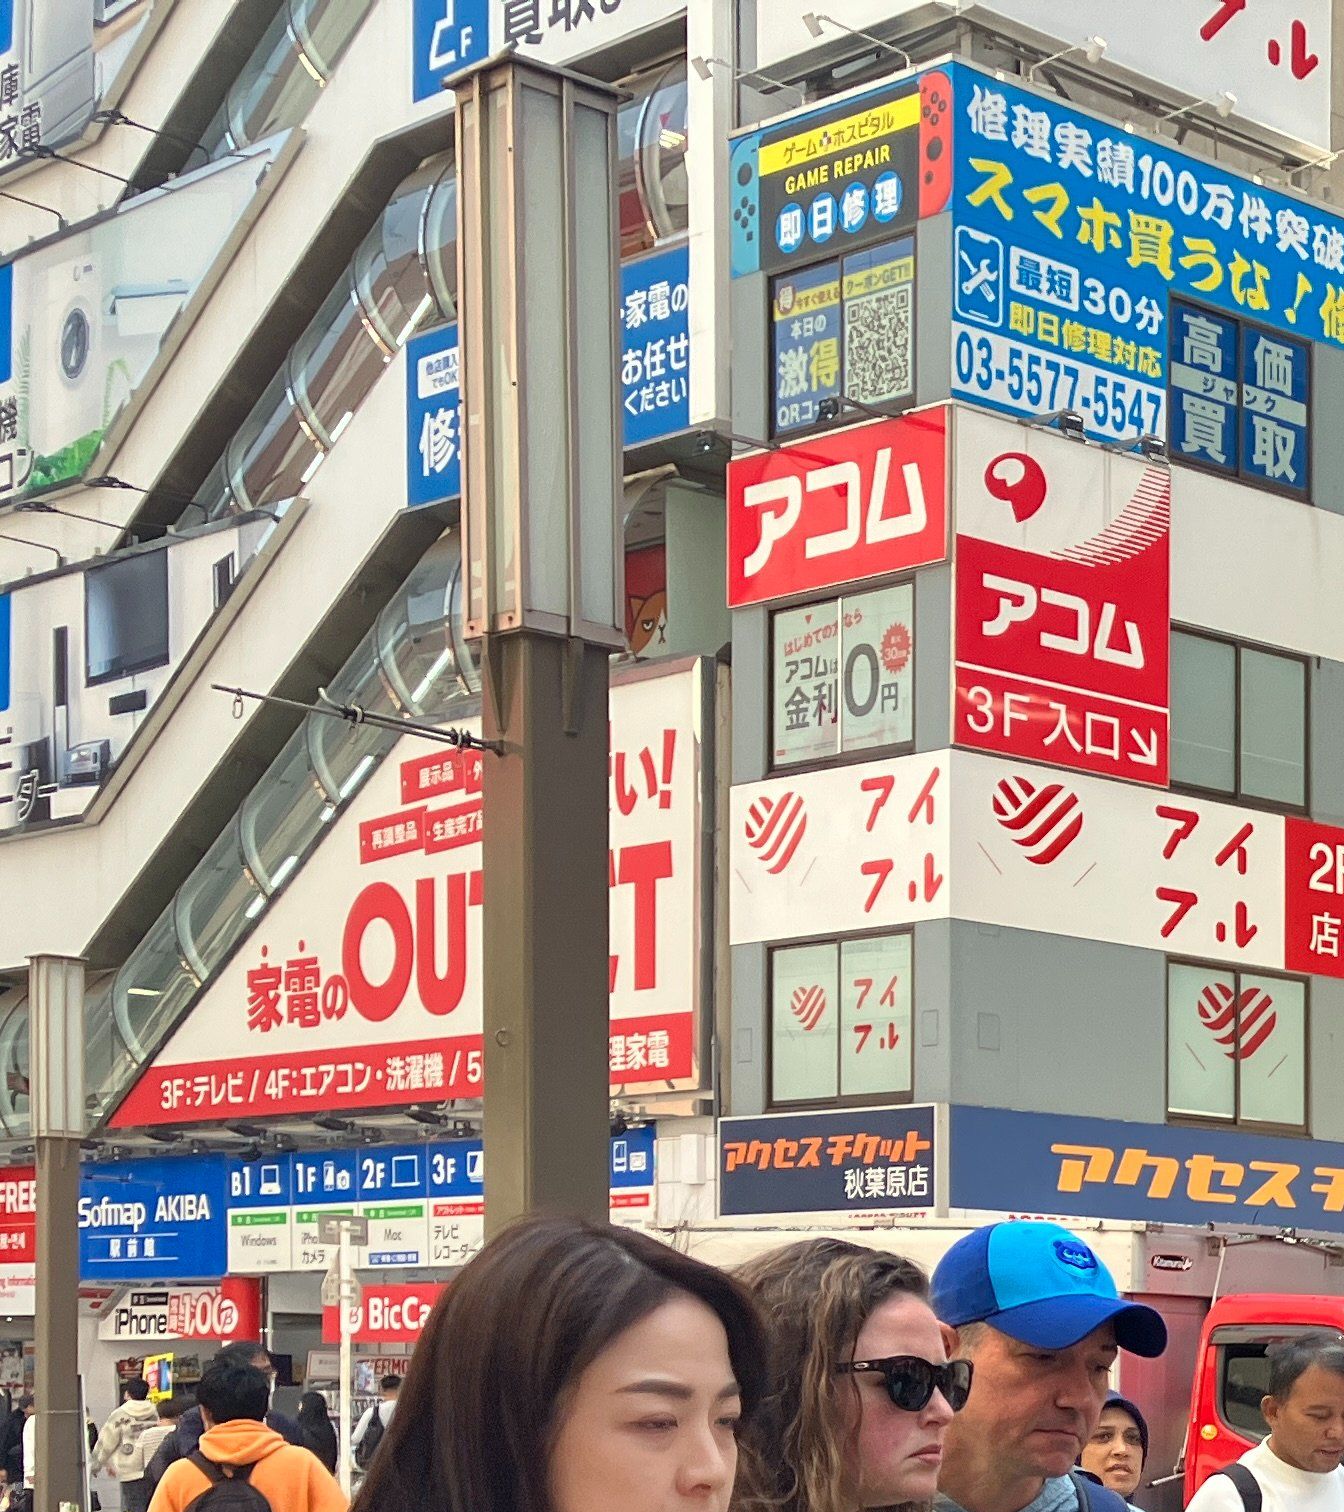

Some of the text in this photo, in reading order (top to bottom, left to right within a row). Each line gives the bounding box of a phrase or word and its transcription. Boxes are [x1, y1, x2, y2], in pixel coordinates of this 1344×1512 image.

[785, 144, 891, 195] GAME REPAIR
[967, 84, 1344, 275] 修理実績100万件突破
[779, 175, 899, 246] 即日修理
[621, 332, 689, 386] お任せ
[1009, 301, 1163, 378] 即日修理対応
[1181, 313, 1295, 398] 高価
[624, 377, 688, 416] ください
[955, 331, 1162, 438] 03-5577-5547
[1181, 396, 1297, 484] 買取
[743, 447, 927, 578] アコム
[982, 572, 1145, 670] アコム
[230, 1166, 251, 1197] B1
[295, 1162, 317, 1193] 1F
[362, 1158, 386, 1190] 2F
[432, 1153, 457, 1185] 3F
[844, 1165, 929, 1200] 秋葉原店
[78, 1193, 211, 1233] Sofmap AKIBA
[240, 1230, 278, 1247] Windows
[114, 1306, 168, 1336] iPhone
